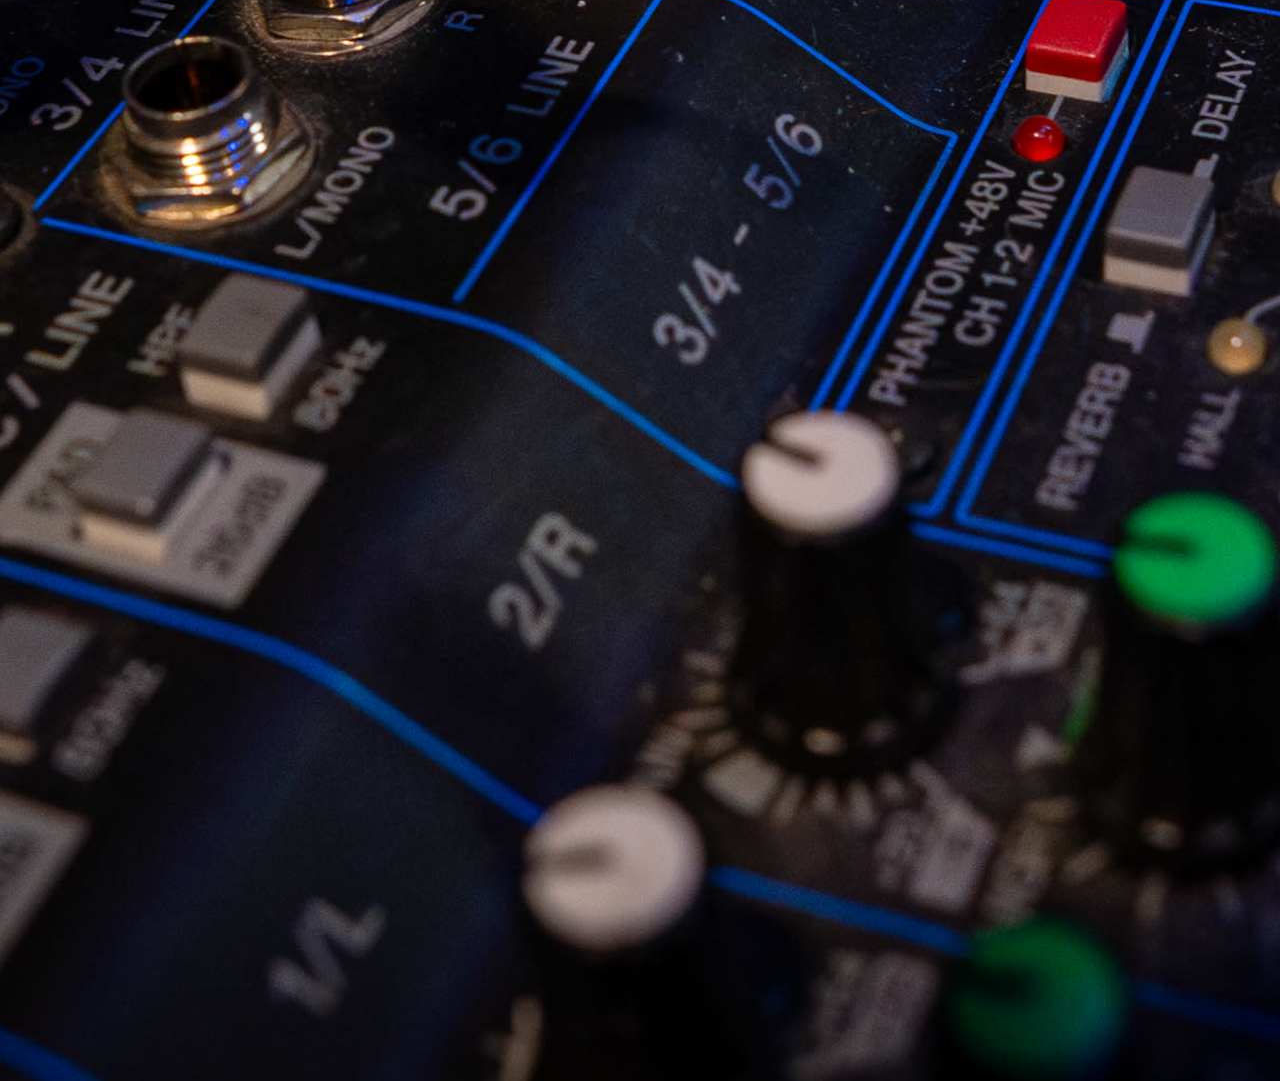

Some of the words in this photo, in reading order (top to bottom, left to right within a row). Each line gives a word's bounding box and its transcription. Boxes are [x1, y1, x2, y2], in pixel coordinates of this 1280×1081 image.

[443, 7, 486, 33] R
[29, 52, 126, 132] 3/4
[427, 133, 524, 222] 5/6
[504, 34, 596, 119] LINE
[1190, 50, 1257, 141] DELAY
[275, 124, 396, 261] L/MONO
[651, 255, 741, 367] 3/4
[742, 112, 823, 211] 5/6
[952, 294, 1002, 349] CH
[983, 237, 1035, 292] 1-2
[1020, 169, 1067, 232] MIC
[5, 373, 43, 411] /
[24, 268, 137, 372] LINE
[868, 230, 980, 407] PHANTOM
[960, 158, 1019, 237] +48V
[1034, 360, 1133, 512] REVERB
[1176, 382, 1241, 471] HALL
[487, 510, 601, 654] 2/R
